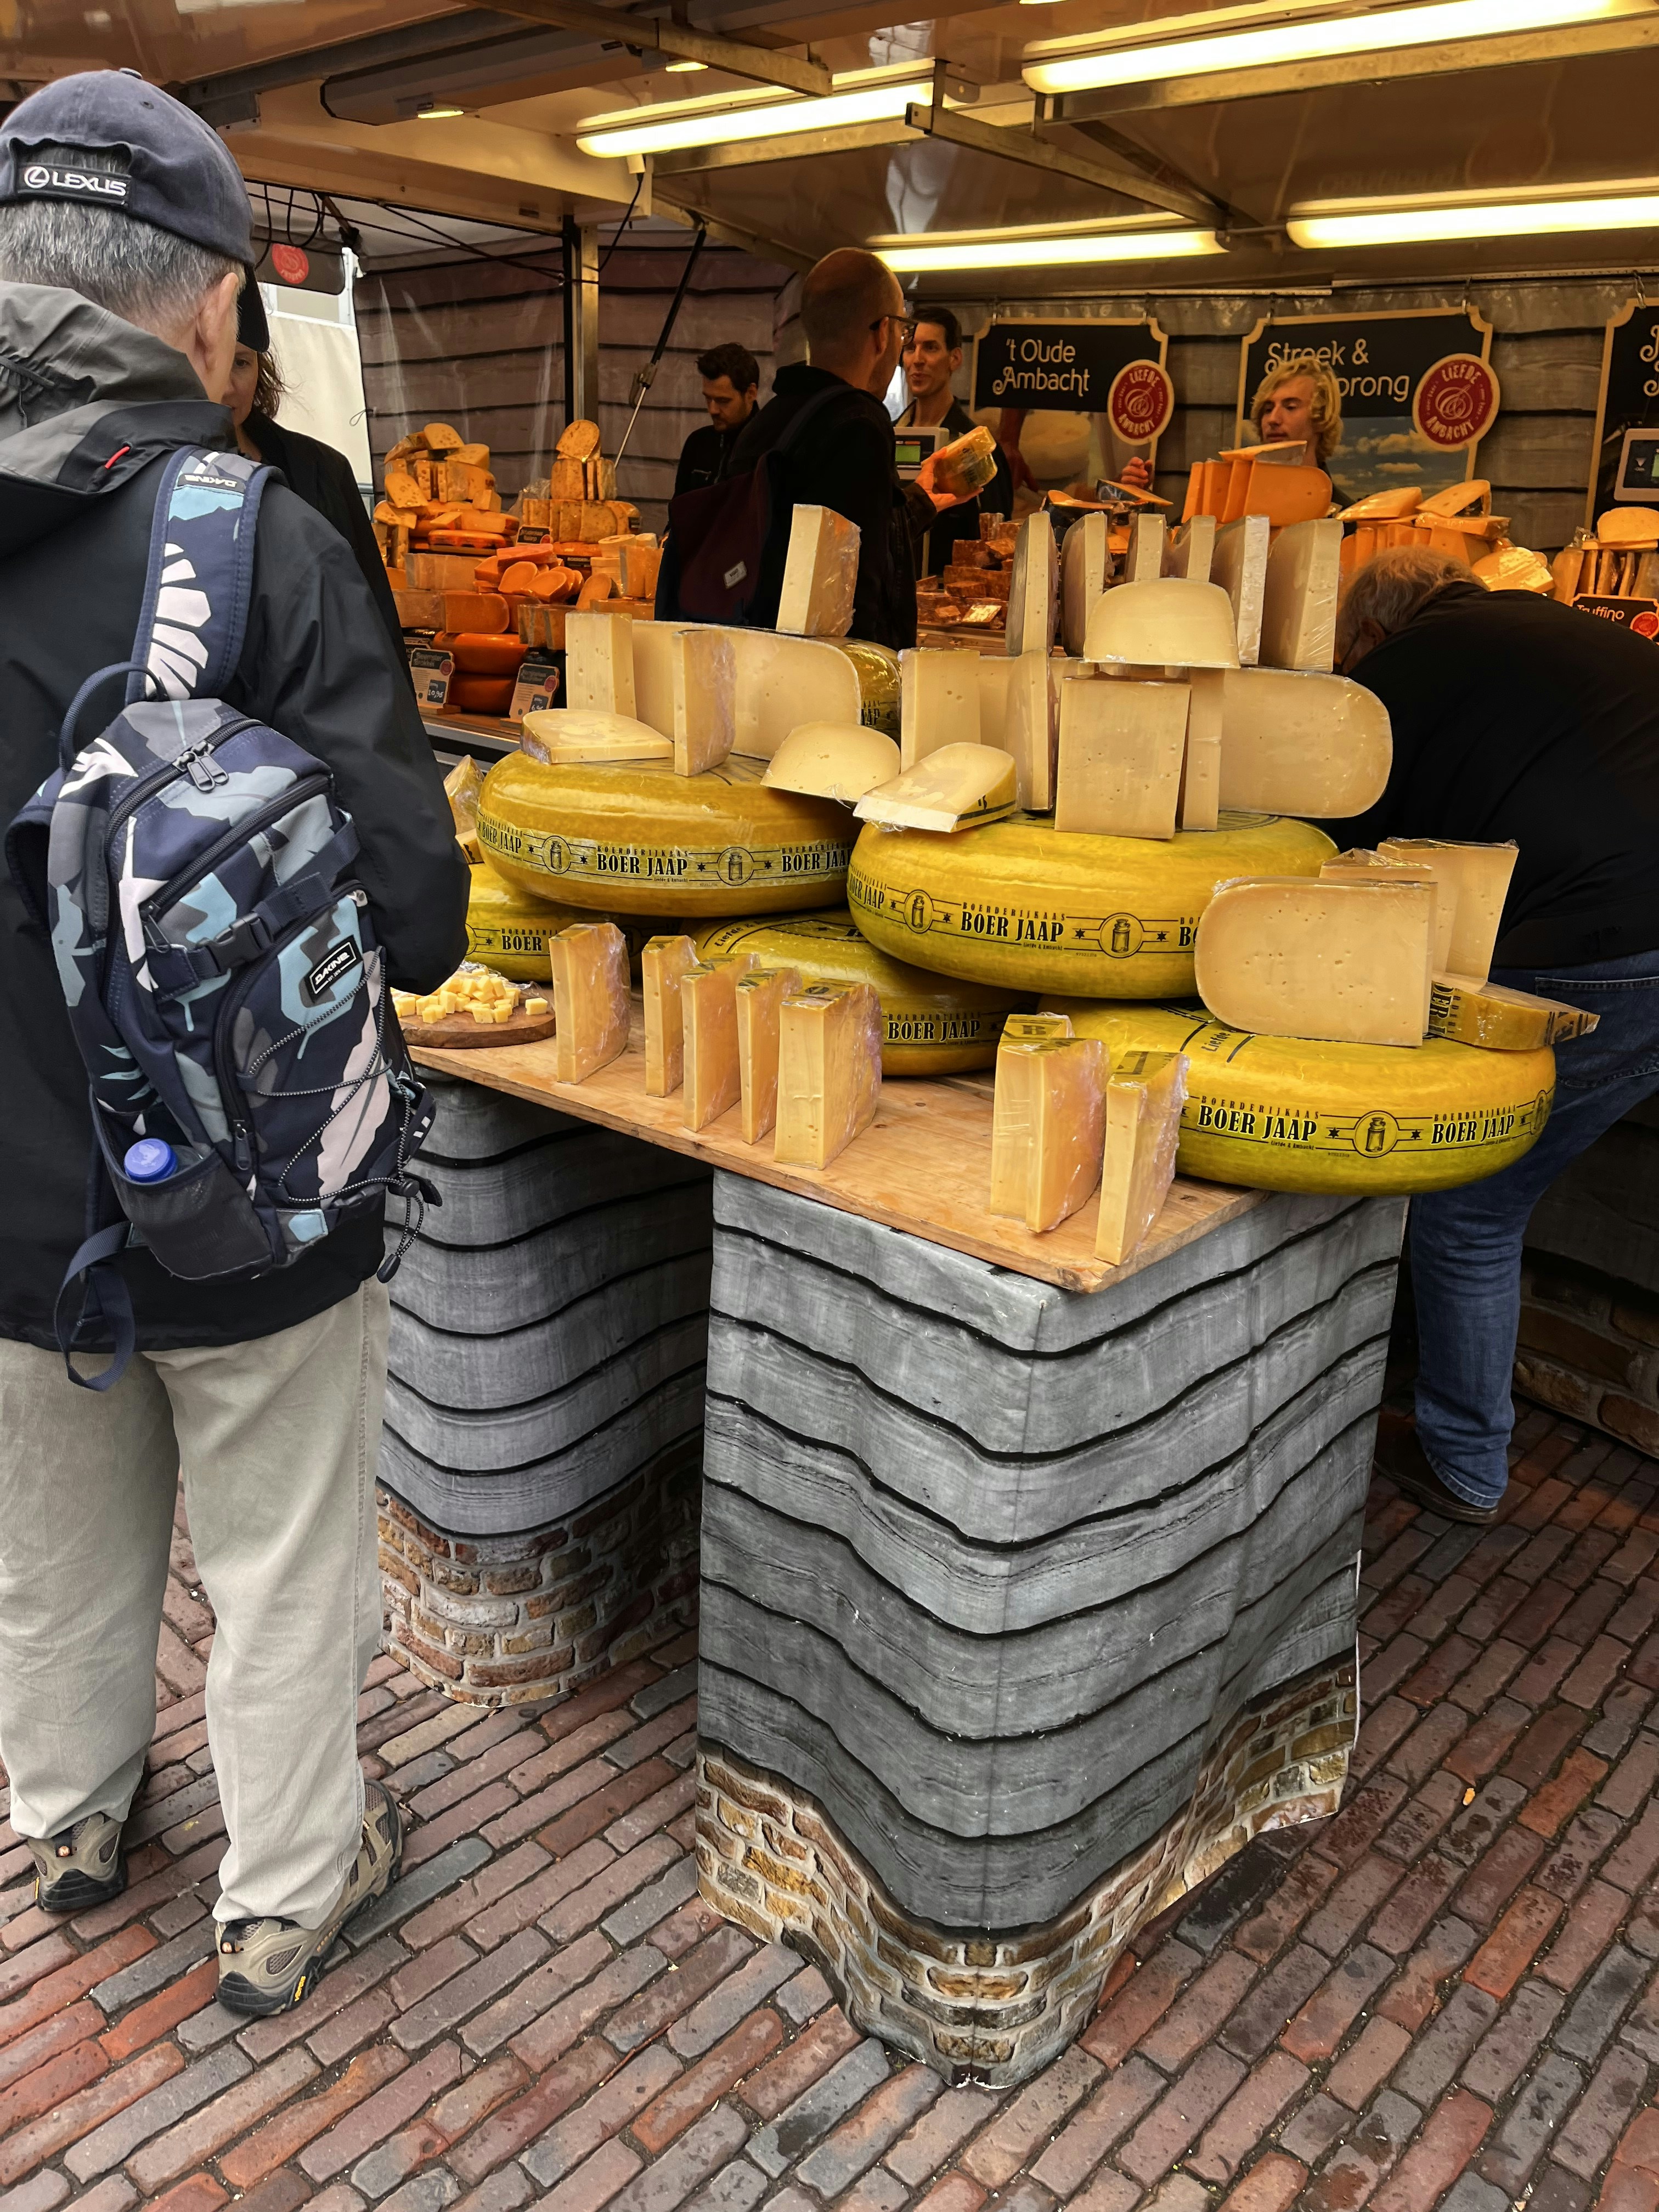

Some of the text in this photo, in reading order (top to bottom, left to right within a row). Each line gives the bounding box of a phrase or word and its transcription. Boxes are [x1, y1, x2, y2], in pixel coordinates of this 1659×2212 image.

[52, 171, 127, 196] LEXUS
[1020, 338, 1076, 363] Oude
[1264, 338, 1369, 375] Streek &
[992, 366, 1091, 397] Ambacht
[1128, 369, 1161, 387] LIEFDE
[1441, 364, 1482, 385] LIEFDE
[1118, 413, 1155, 436] AMBACHT
[1425, 416, 1475, 441] AMBACHT
[184, 474, 238, 488] DAKINE
[482, 821, 498, 845] BOER
[499, 831, 522, 854] JAAP
[597, 845, 689, 858] BOERDERIJKAAS
[782, 853, 821, 872] BOER
[596, 853, 688, 878] BOER JAAP
[863, 884, 885, 910] JAAP
[962, 901, 1065, 921] BOERDERIJKAAS
[961, 911, 1064, 942] BOER JAAP
[501, 935, 543, 951] BOER
[314, 952, 351, 985] DAKINE
[888, 1020, 980, 1042] BOER JAAP
[1201, 1031, 1231, 1052] Liefde
[1201, 1095, 1319, 1120] BOERDERIJKAAS
[1198, 1104, 1317, 1141] BOER JAAP
[1431, 1114, 1515, 1144] BOER JAAP
